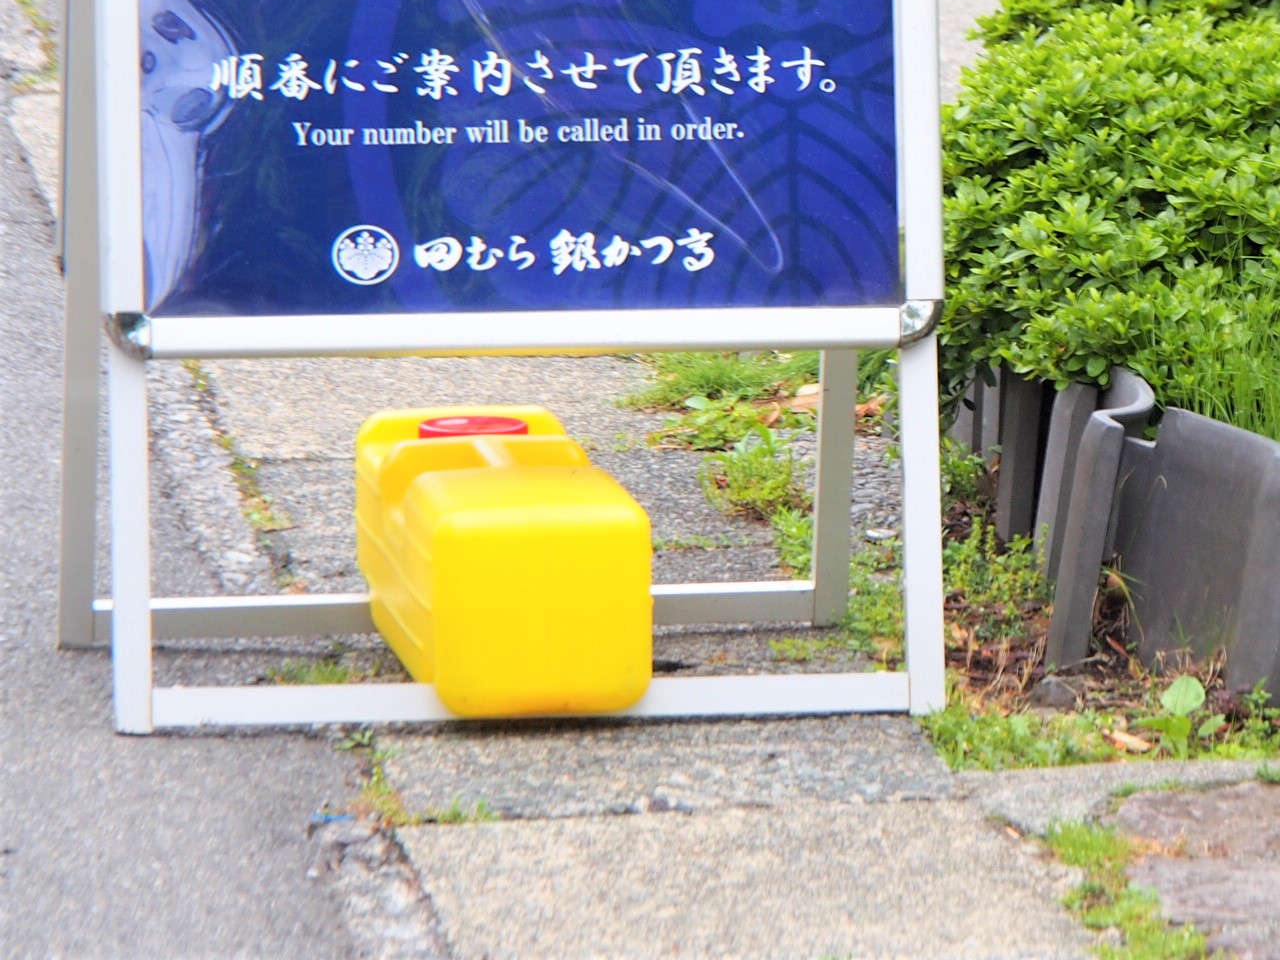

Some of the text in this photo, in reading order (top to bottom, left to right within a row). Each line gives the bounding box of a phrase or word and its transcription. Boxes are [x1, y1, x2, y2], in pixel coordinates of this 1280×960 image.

[210, 45, 838, 100] 順番にご案内させて頂きます。
[292, 116, 745, 145] Your number will be called in order.
[414, 235, 536, 272] 田むら
